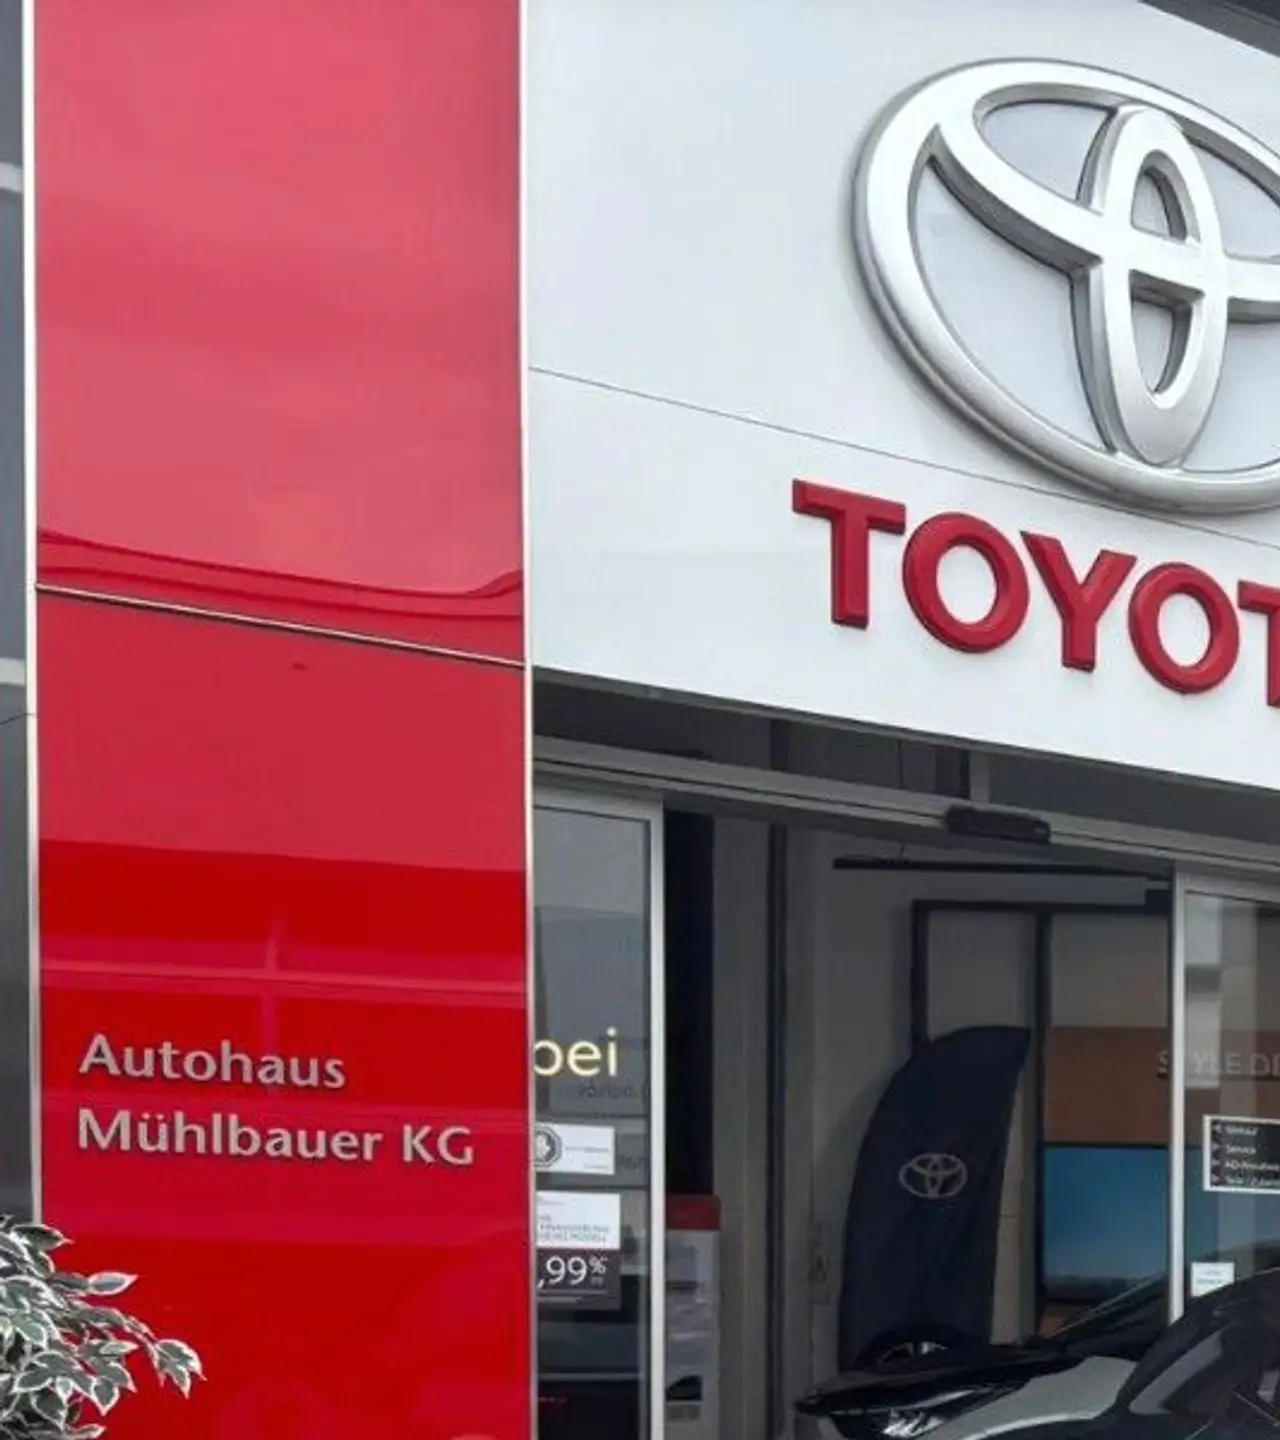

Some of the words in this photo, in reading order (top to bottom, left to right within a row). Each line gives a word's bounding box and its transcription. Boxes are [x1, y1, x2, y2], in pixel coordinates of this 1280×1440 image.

[78, 1033, 346, 1089] Autohaus
[78, 1108, 384, 1162] Mühlbauer
[402, 1123, 474, 1166] KG
